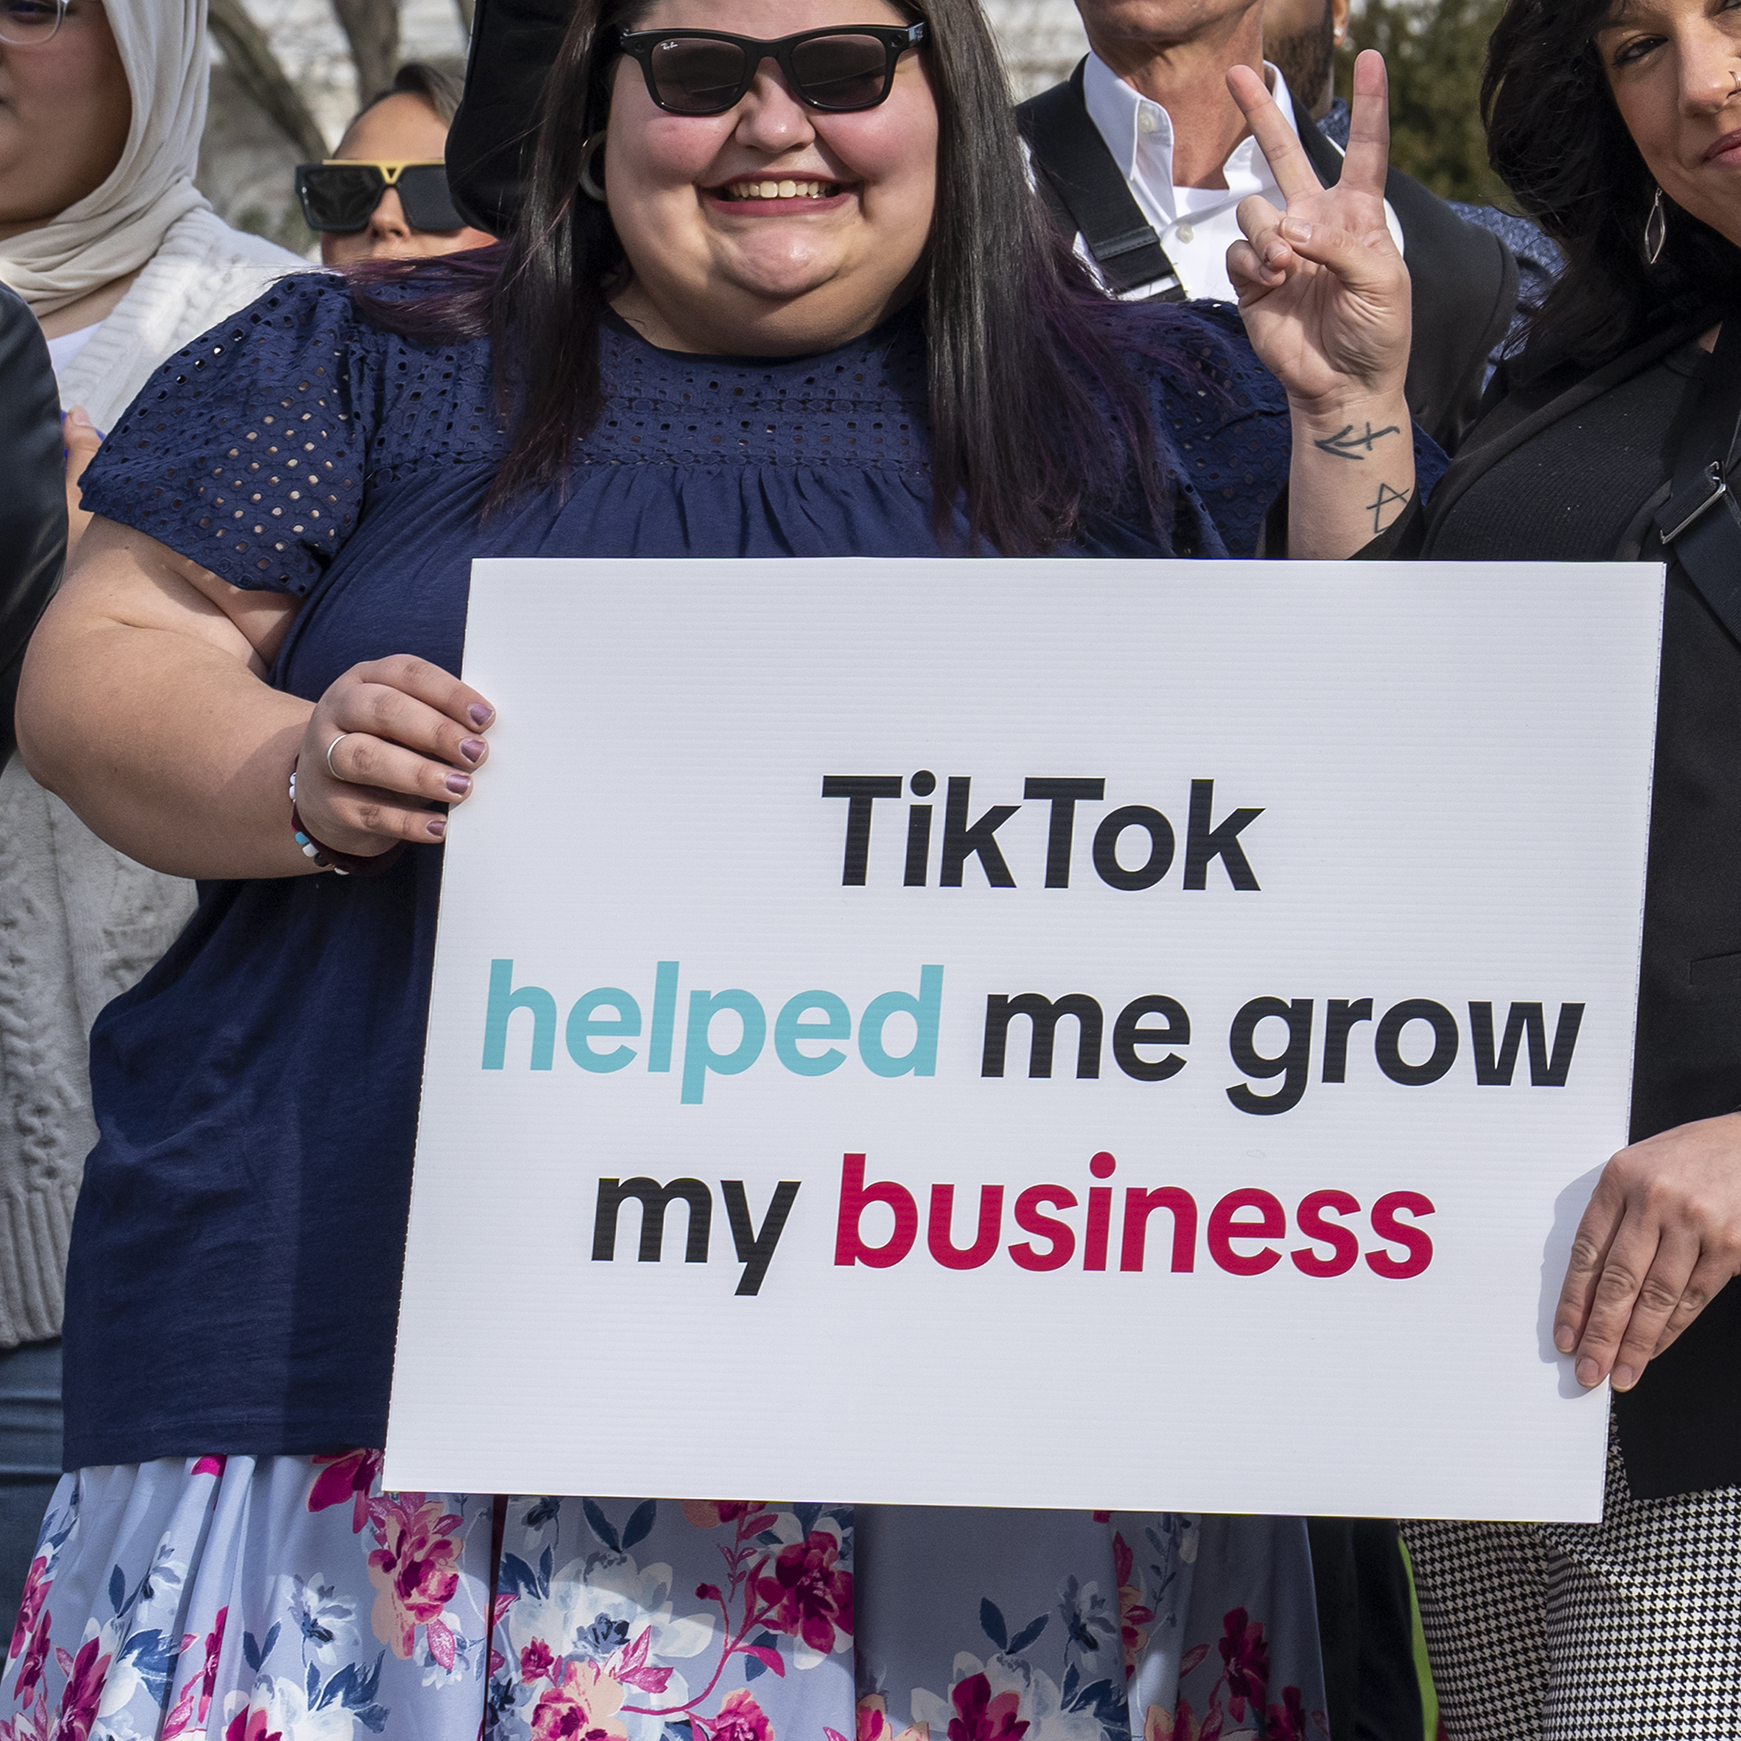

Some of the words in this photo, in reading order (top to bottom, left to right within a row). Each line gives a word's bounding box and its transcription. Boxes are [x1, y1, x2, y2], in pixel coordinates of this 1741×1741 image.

[820, 769, 1267, 893] TikTok
[481, 958, 945, 1105] helped
[979, 992, 1192, 1084] me
[1224, 995, 1587, 1117] grow
[590, 1175, 803, 1298] my
[832, 1150, 1437, 1281] business
